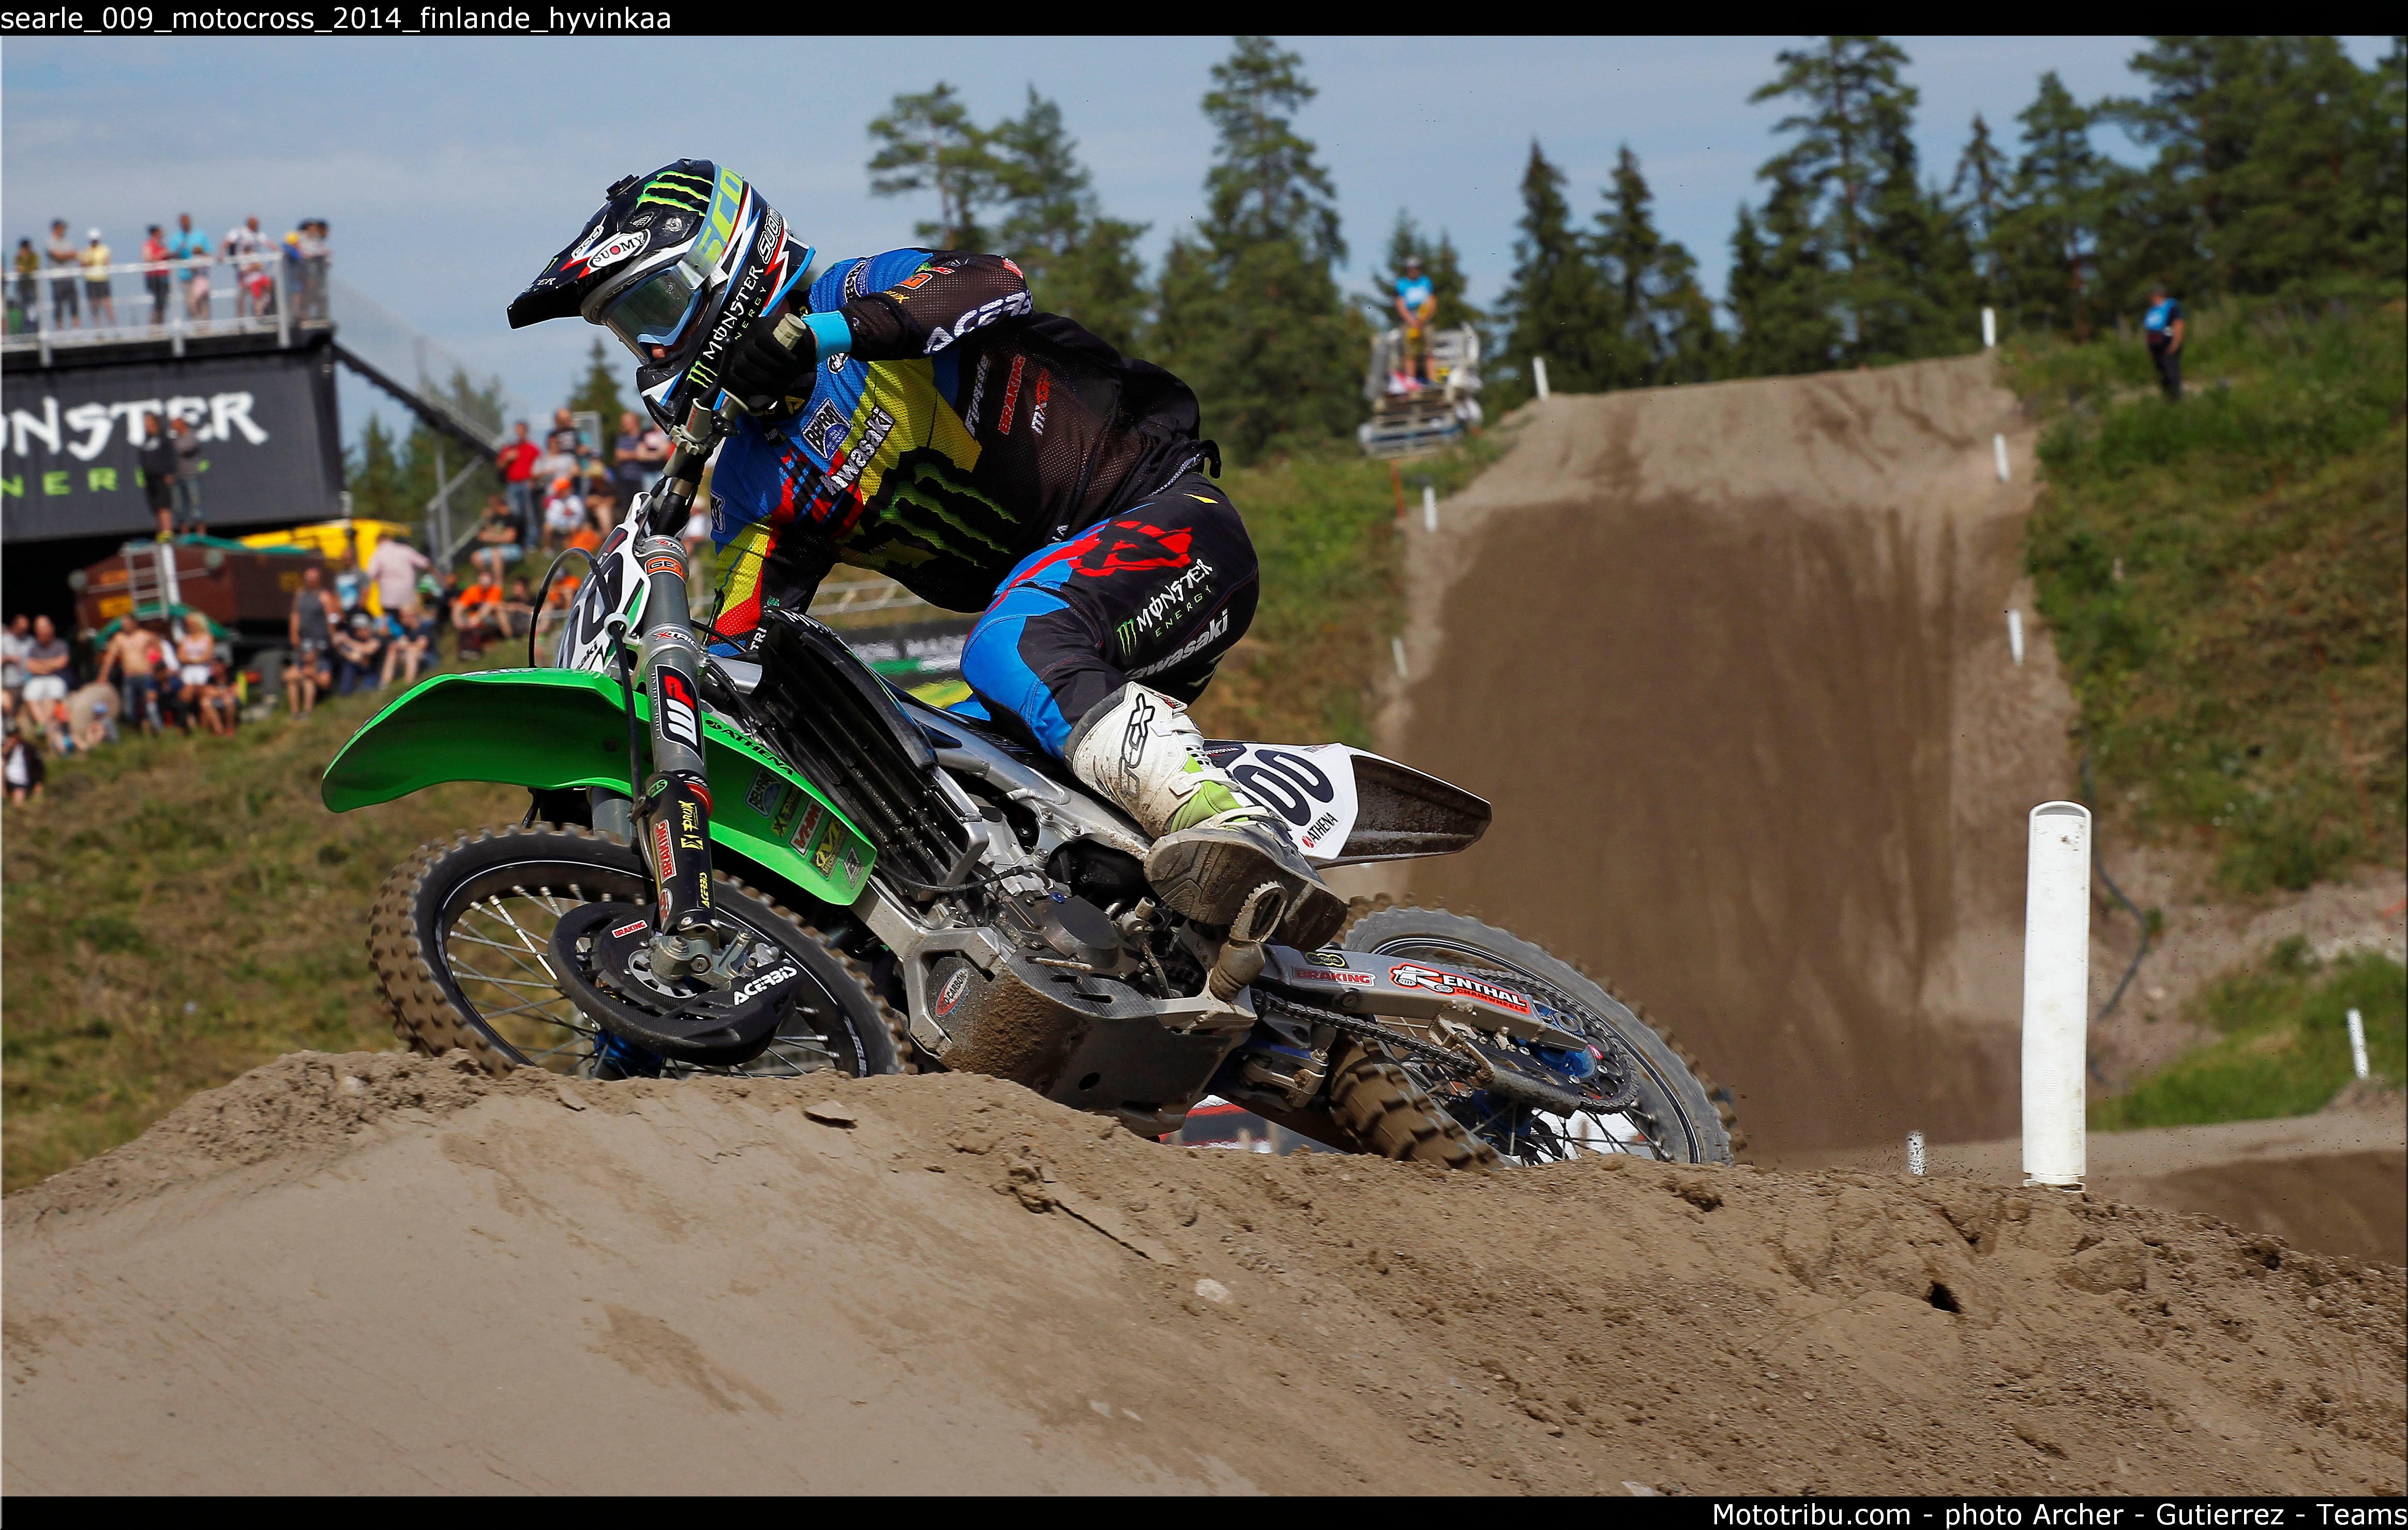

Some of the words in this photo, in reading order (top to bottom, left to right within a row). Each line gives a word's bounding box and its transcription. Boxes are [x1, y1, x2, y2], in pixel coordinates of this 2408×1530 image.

[594, 234, 646, 262] SUOMY
[702, 264, 766, 360] MONSTER
[734, 286, 766, 340] NERGY
[998, 354, 1026, 435] BRAKING
[0, 391, 269, 462] NSTER
[1136, 558, 1213, 632] MONSTER
[1155, 584, 1212, 637] ENERGY
[1124, 608, 1228, 680] awasaki
[721, 729, 794, 775] ATHENA
[1229, 749, 1334, 826] 00
[656, 821, 674, 878] BRAKING
[1307, 812, 1339, 845] ATHENA
[699, 872, 710, 909] ACERBIS
[614, 921, 646, 937] BRAKING
[734, 966, 797, 1006] ACERBIS
[1296, 968, 1371, 984] BRAKING
[1392, 965, 1527, 1008] RENTHAL
[1455, 987, 1527, 1013] CHAINWHEELS
